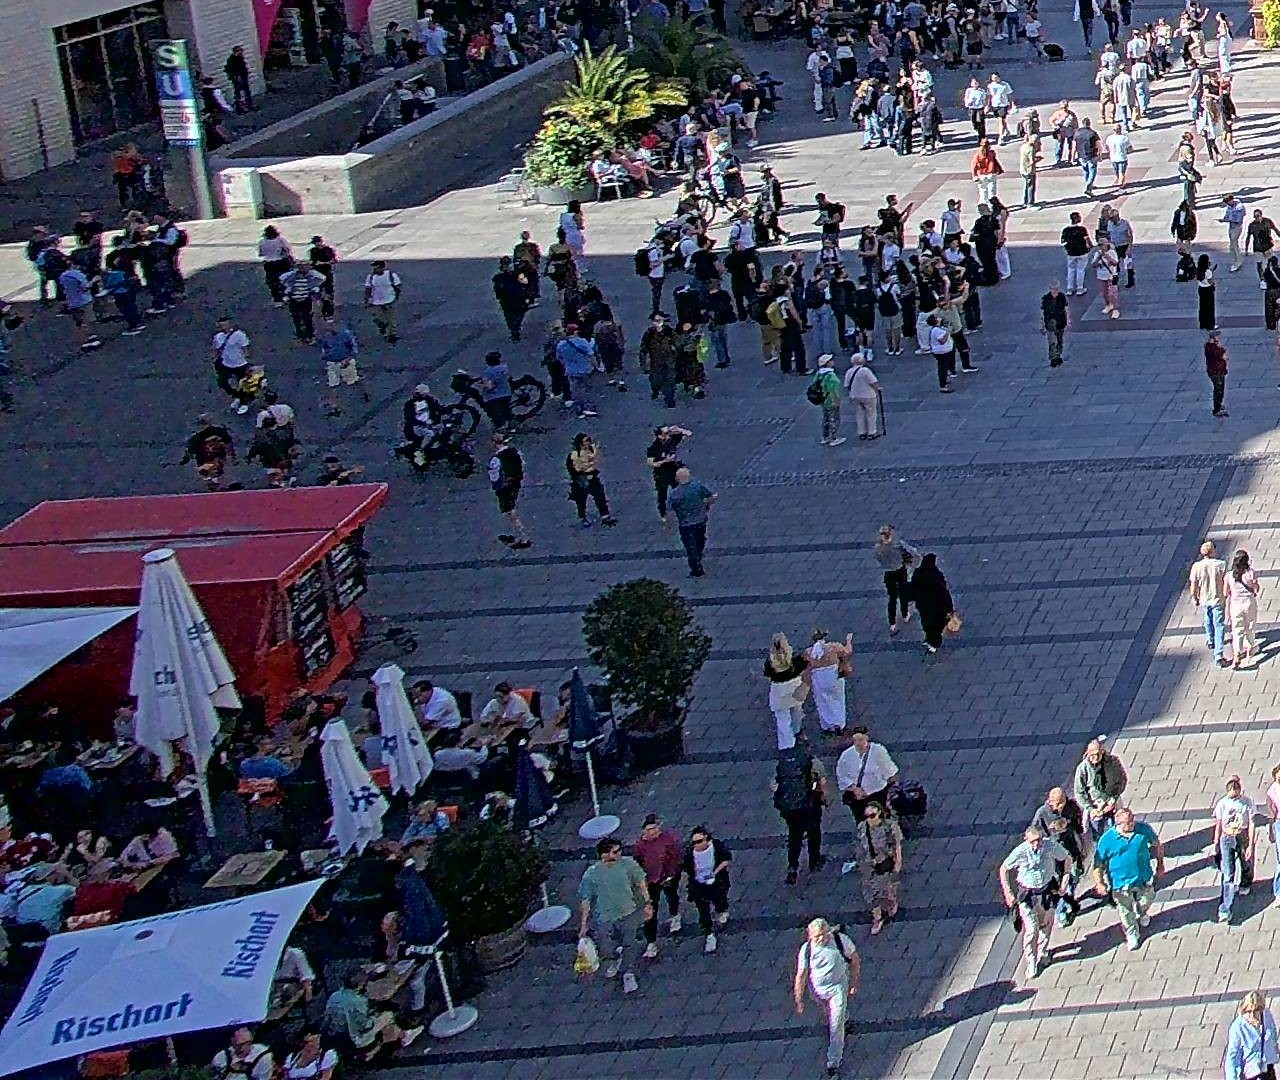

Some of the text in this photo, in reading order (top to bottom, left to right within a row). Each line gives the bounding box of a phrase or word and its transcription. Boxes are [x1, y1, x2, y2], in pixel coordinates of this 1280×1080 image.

[157, 45, 179, 68] S
[162, 74, 183, 97] U
[221, 909, 280, 980] Rischart
[51, 991, 194, 1046] Rischart
